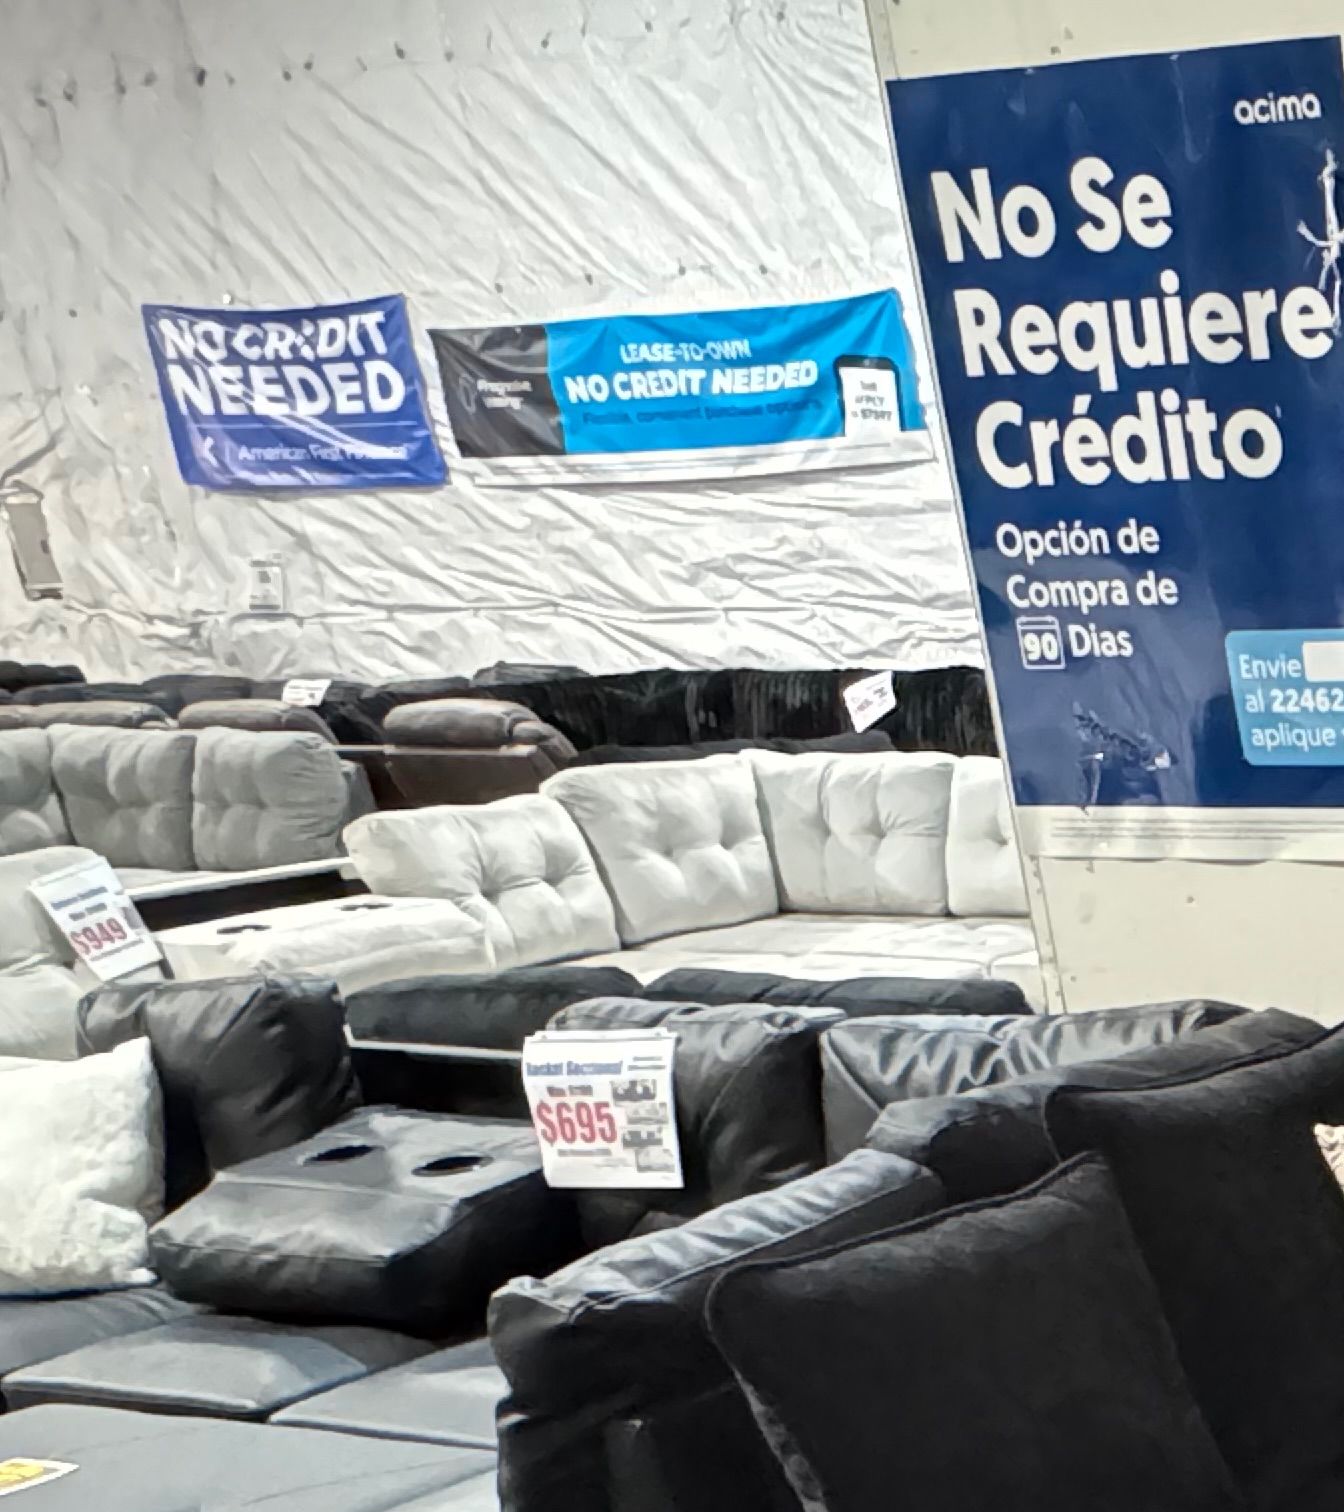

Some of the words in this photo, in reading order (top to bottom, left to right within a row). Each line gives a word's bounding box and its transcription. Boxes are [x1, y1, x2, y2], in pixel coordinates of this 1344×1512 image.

[1234, 92, 1322, 125] acima
[930, 167, 1056, 263] No
[1069, 156, 1173, 252] Se
[158, 318, 228, 361] NO
[620, 339, 752, 364] LEASE-TO-OWN
[953, 269, 1335, 392] Requiere
[166, 360, 406, 416] NEEDED
[564, 374, 610, 404] NO
[613, 368, 707, 400] CREDIT
[712, 360, 819, 395] NEEDED
[975, 388, 1283, 489] Crédito
[996, 519, 1111, 566] Opción
[1117, 517, 1160, 555] de
[1006, 574, 1130, 615] Compra
[1136, 569, 1179, 606] de
[1023, 632, 1059, 661] 90
[1238, 653, 1302, 680] Envie
[1245, 688, 1265, 713] al
[1251, 722, 1336, 752] aplique
[536, 1100, 618, 1145] $695
